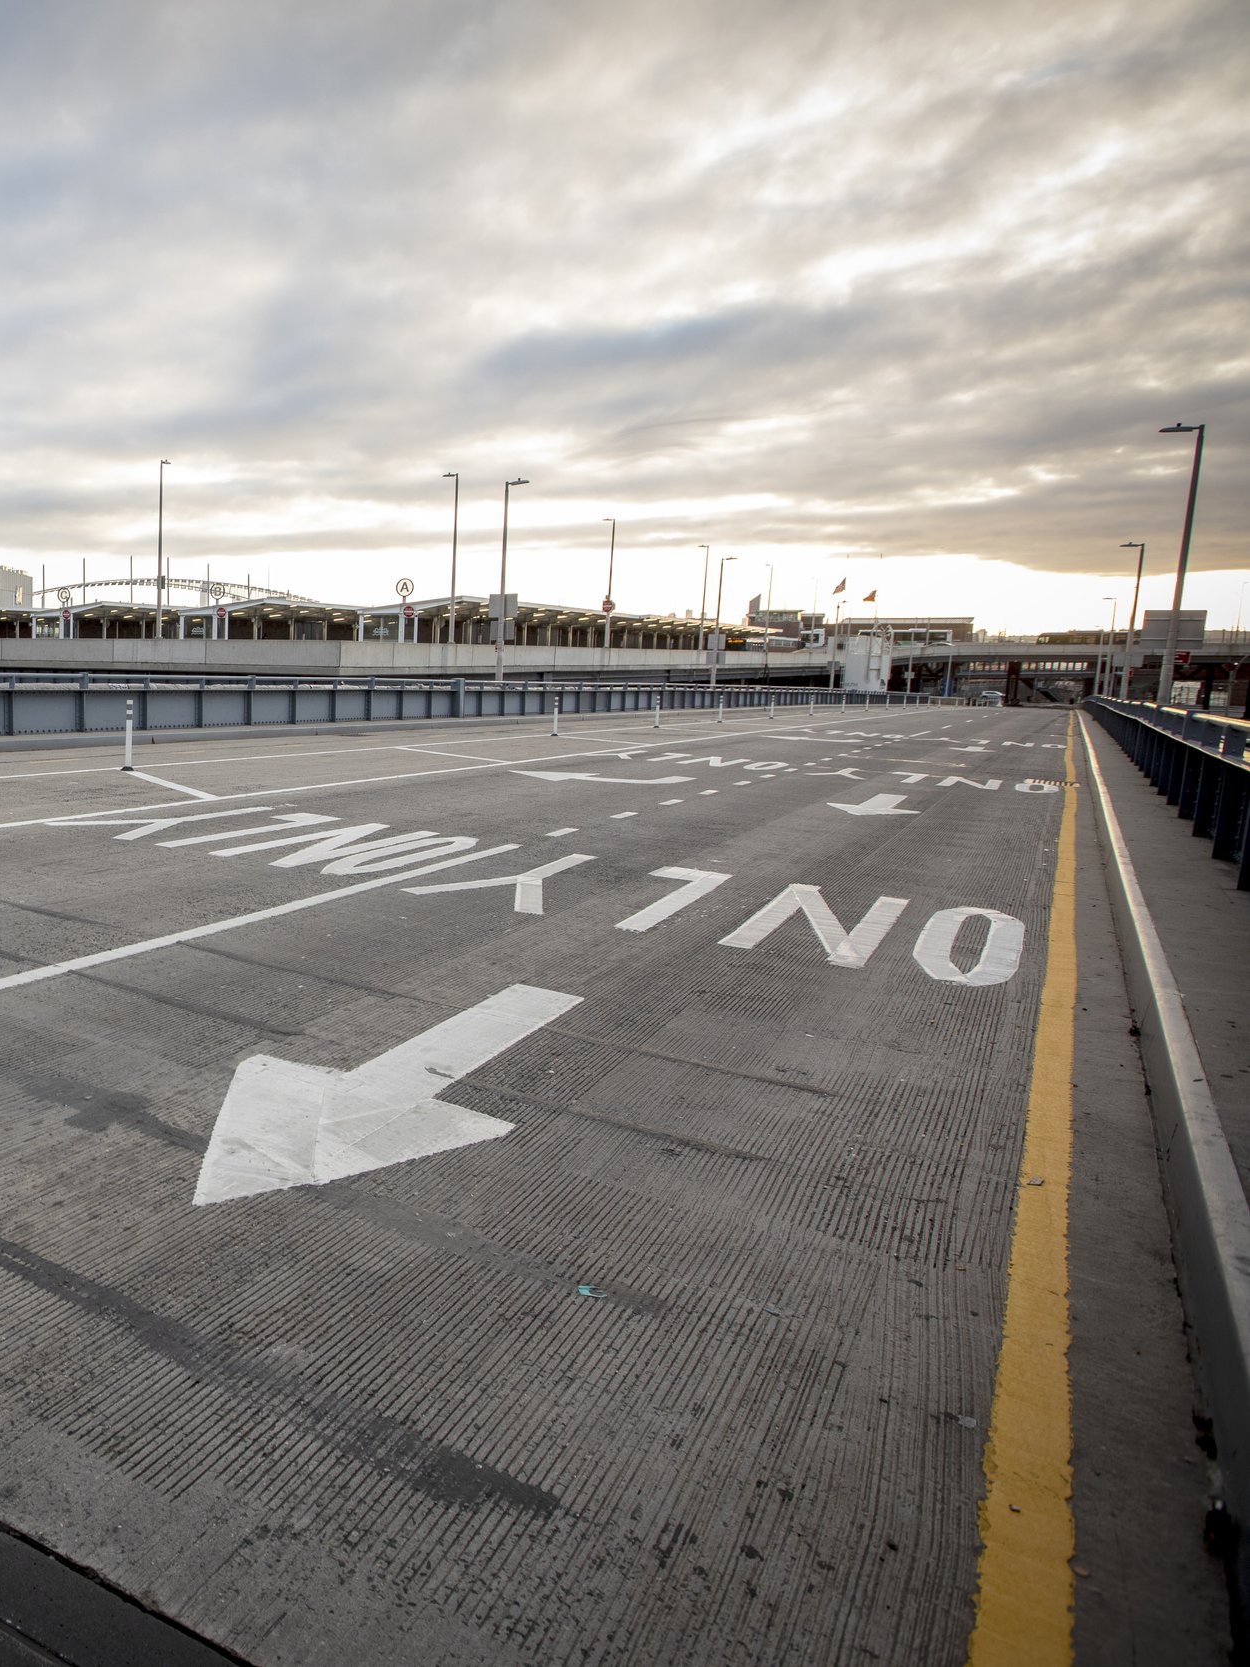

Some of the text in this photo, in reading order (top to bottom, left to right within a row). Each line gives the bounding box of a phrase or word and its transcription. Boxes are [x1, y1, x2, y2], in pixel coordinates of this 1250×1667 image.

[583, 750, 790, 771] ONLY
[804, 767, 1059, 794] ONLY
[45, 805, 479, 875] ONLY
[400, 853, 1025, 987] ONLY
